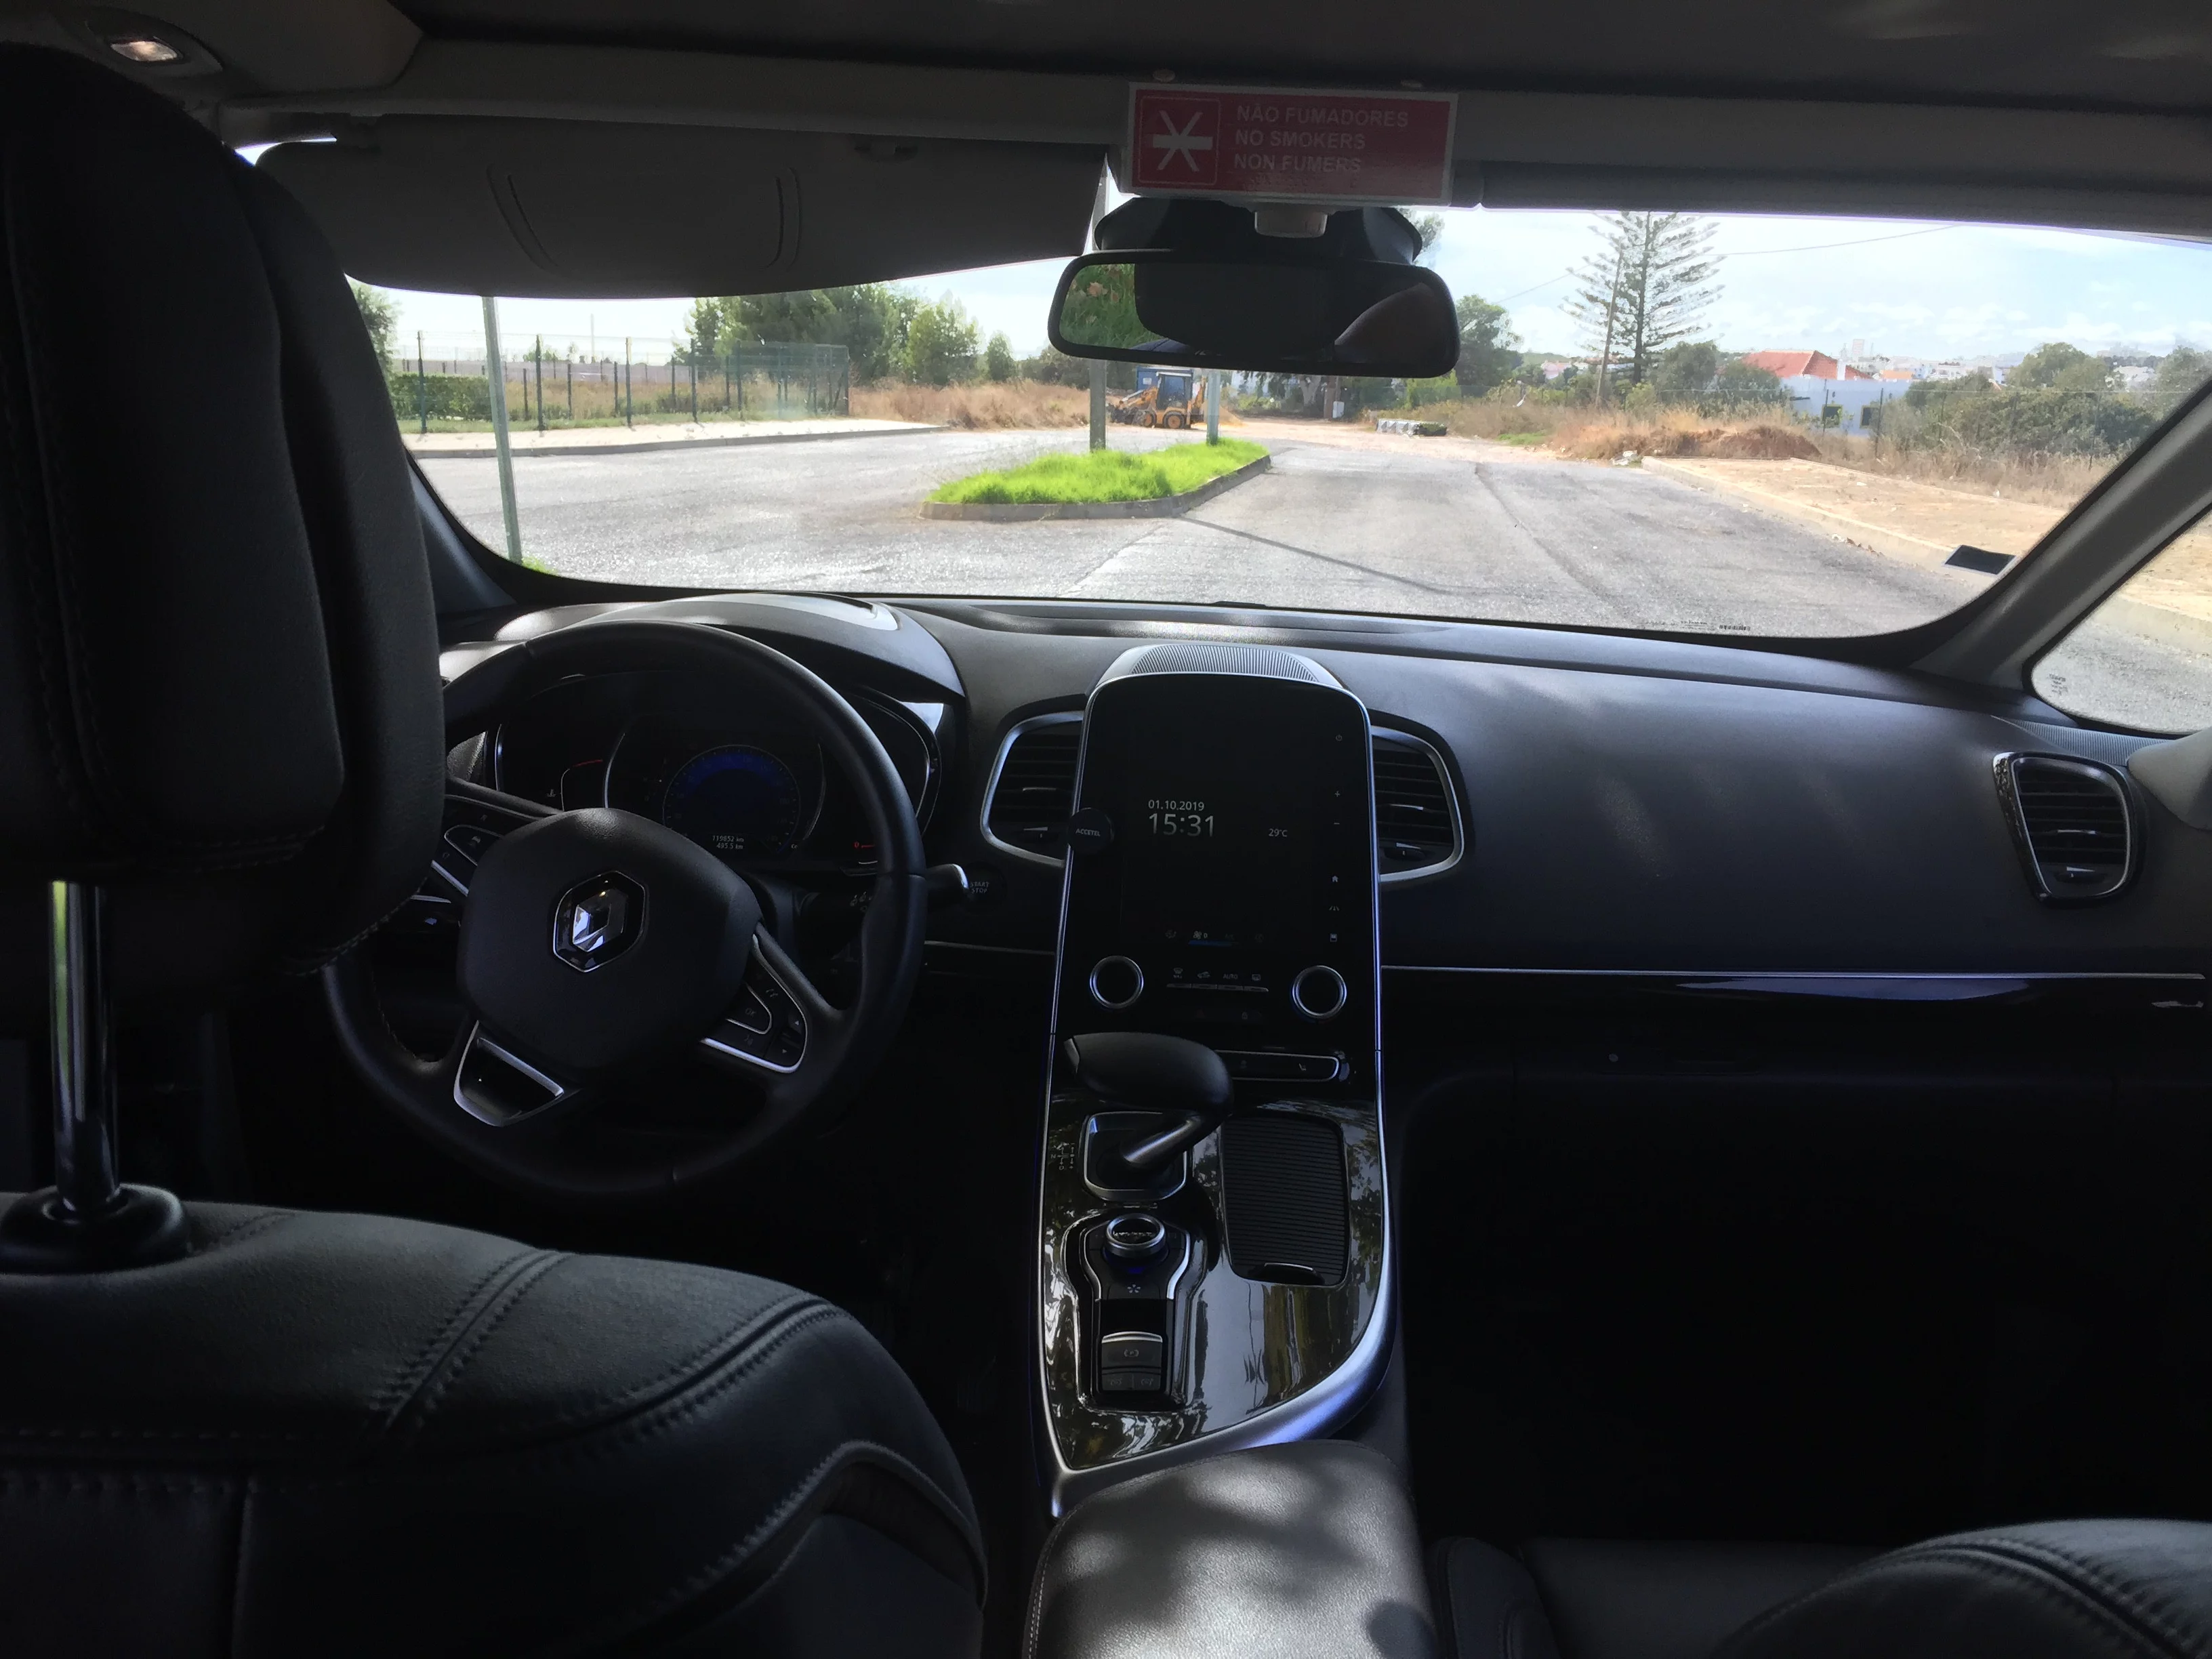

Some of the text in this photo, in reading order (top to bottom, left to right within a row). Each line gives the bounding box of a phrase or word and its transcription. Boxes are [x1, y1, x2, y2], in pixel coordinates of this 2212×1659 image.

[1285, 107, 1409, 127] FUMADORES
[1235, 129, 1366, 150] NO SMOKERS
[1233, 152, 1361, 173] NON FUMERS
[1148, 799, 1205, 811] 01.10.2019
[1149, 813, 1215, 838] 15:31
[745, 1007, 756, 1018] OK
